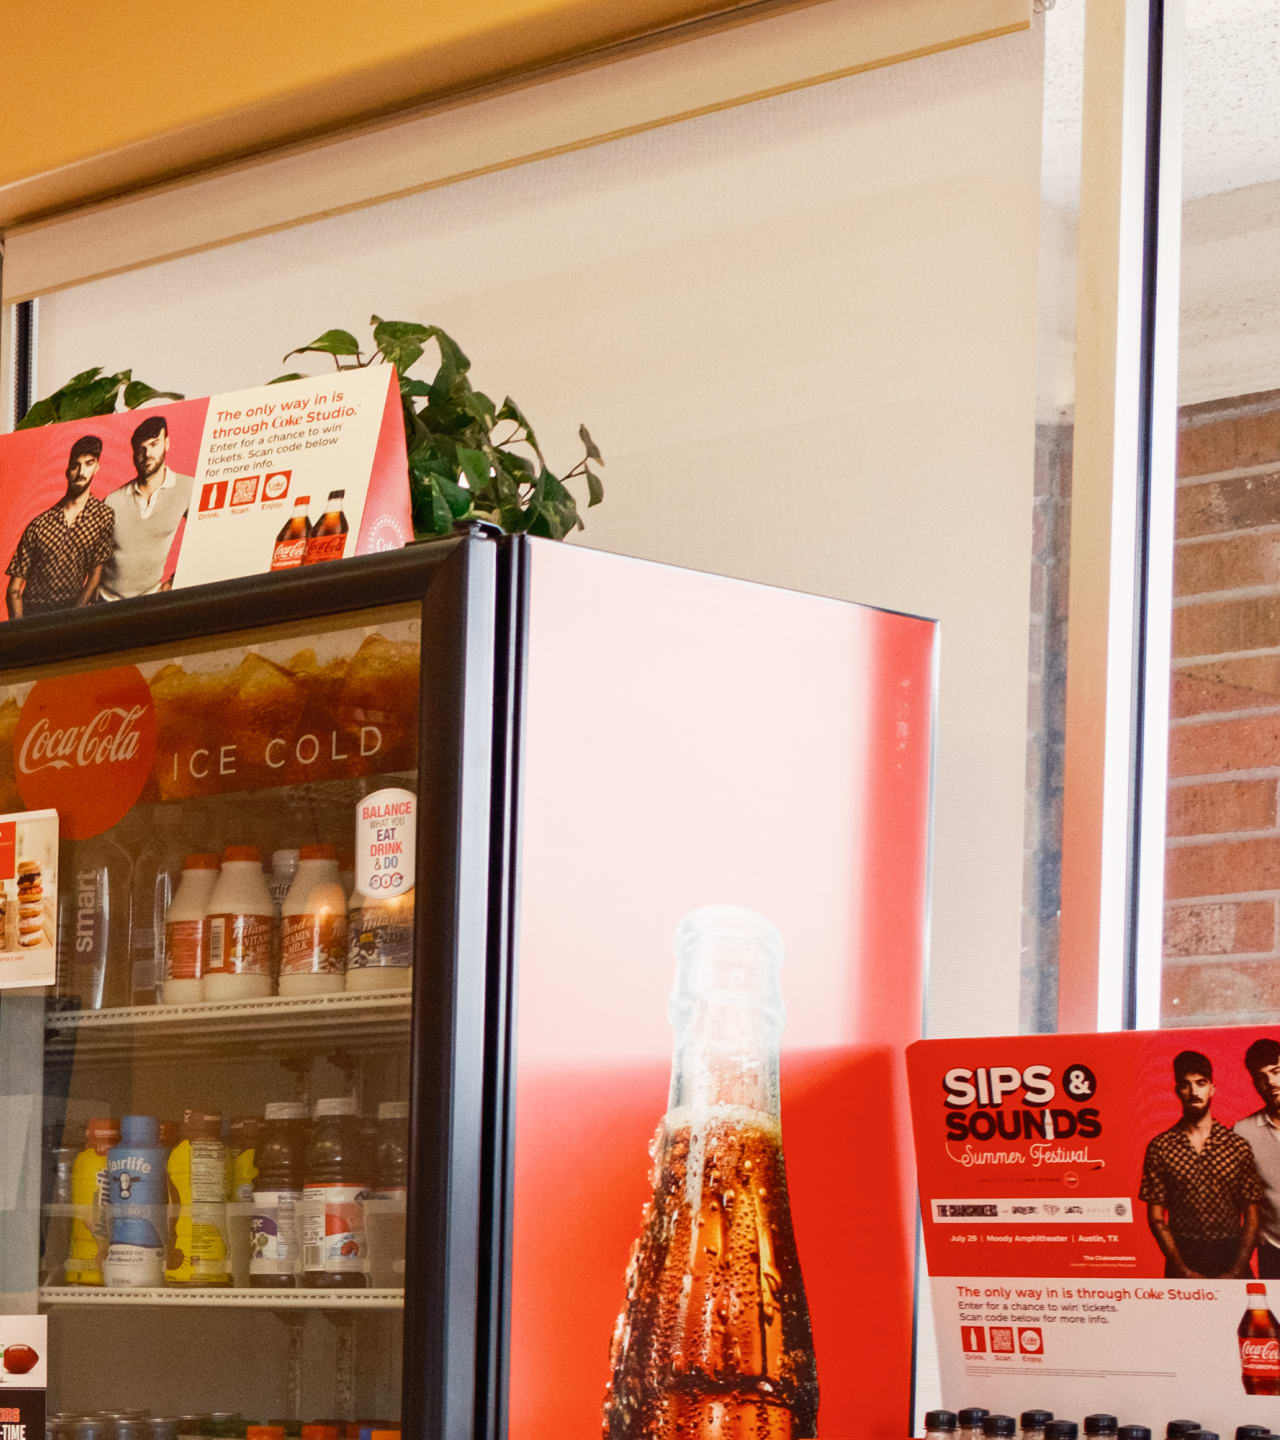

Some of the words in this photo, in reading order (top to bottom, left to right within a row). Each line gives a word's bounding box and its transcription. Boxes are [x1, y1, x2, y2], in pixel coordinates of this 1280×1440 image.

[217, 411, 242, 423] The
[246, 403, 275, 418] only
[281, 399, 310, 412] way
[315, 394, 328, 404] in
[332, 392, 343, 402] is
[212, 420, 268, 439] through
[272, 415, 303, 429] Coke
[210, 442, 237, 453] Enter
[241, 439, 255, 449] for
[267, 432, 305, 444] chance
[308, 428, 319, 436] to
[323, 423, 343, 433] win
[208, 453, 245, 465] tickets.
[248, 448, 273, 459] Scan
[277, 443, 302, 454] code
[305, 437, 339, 449] below
[205, 468, 220, 478] for
[223, 464, 250, 475] more
[253, 459, 274, 470] info.
[19, 704, 149, 775] Coca-Cola
[172, 745, 238, 781] ICE
[265, 726, 383, 768] COLD
[362, 801, 412, 819] BALANCE
[369, 818, 389, 829] WHAT
[391, 816, 405, 827] YOU
[377, 828, 396, 842] EAT
[370, 841, 403, 856] DRINK
[375, 858, 382, 870] &
[384, 856, 398, 869] DO
[76, 870, 96, 952] smart
[943, 1065, 1055, 1110] SIPS
[945, 1108, 1102, 1141] SOUNDS
[945, 1142, 1025, 1167] Summer
[1030, 1143, 1105, 1168] Festival
[950, 1235, 966, 1243] July
[986, 1235, 1012, 1243] Moody
[1015, 1235, 1068, 1243] Amphitheater
[1078, 1235, 1105, 1243] Austin,
[956, 1286, 980, 1298] The
[984, 1286, 1011, 1299] only
[1014, 1288, 1042, 1300] way
[1046, 1288, 1058, 1298] in
[1062, 1288, 1072, 1299] is
[1077, 1288, 1132, 1301] through
[1134, 1287, 1164, 1300] Coke
[958, 1301, 984, 1310] Enter
[986, 1301, 1000, 1311] for
[1010, 1302, 1045, 1311] chance
[1047, 1303, 1058, 1311] to
[1061, 1303, 1079, 1312] win
[1083, 1304, 1118, 1313] tickets.
[960, 1313, 983, 1322] Scan
[985, 1313, 1008, 1322] code
[1010, 1314, 1040, 1323] below
[1043, 1314, 1057, 1323] for
[1060, 1315, 1085, 1324] more
[1088, 1315, 1109, 1324] info.
